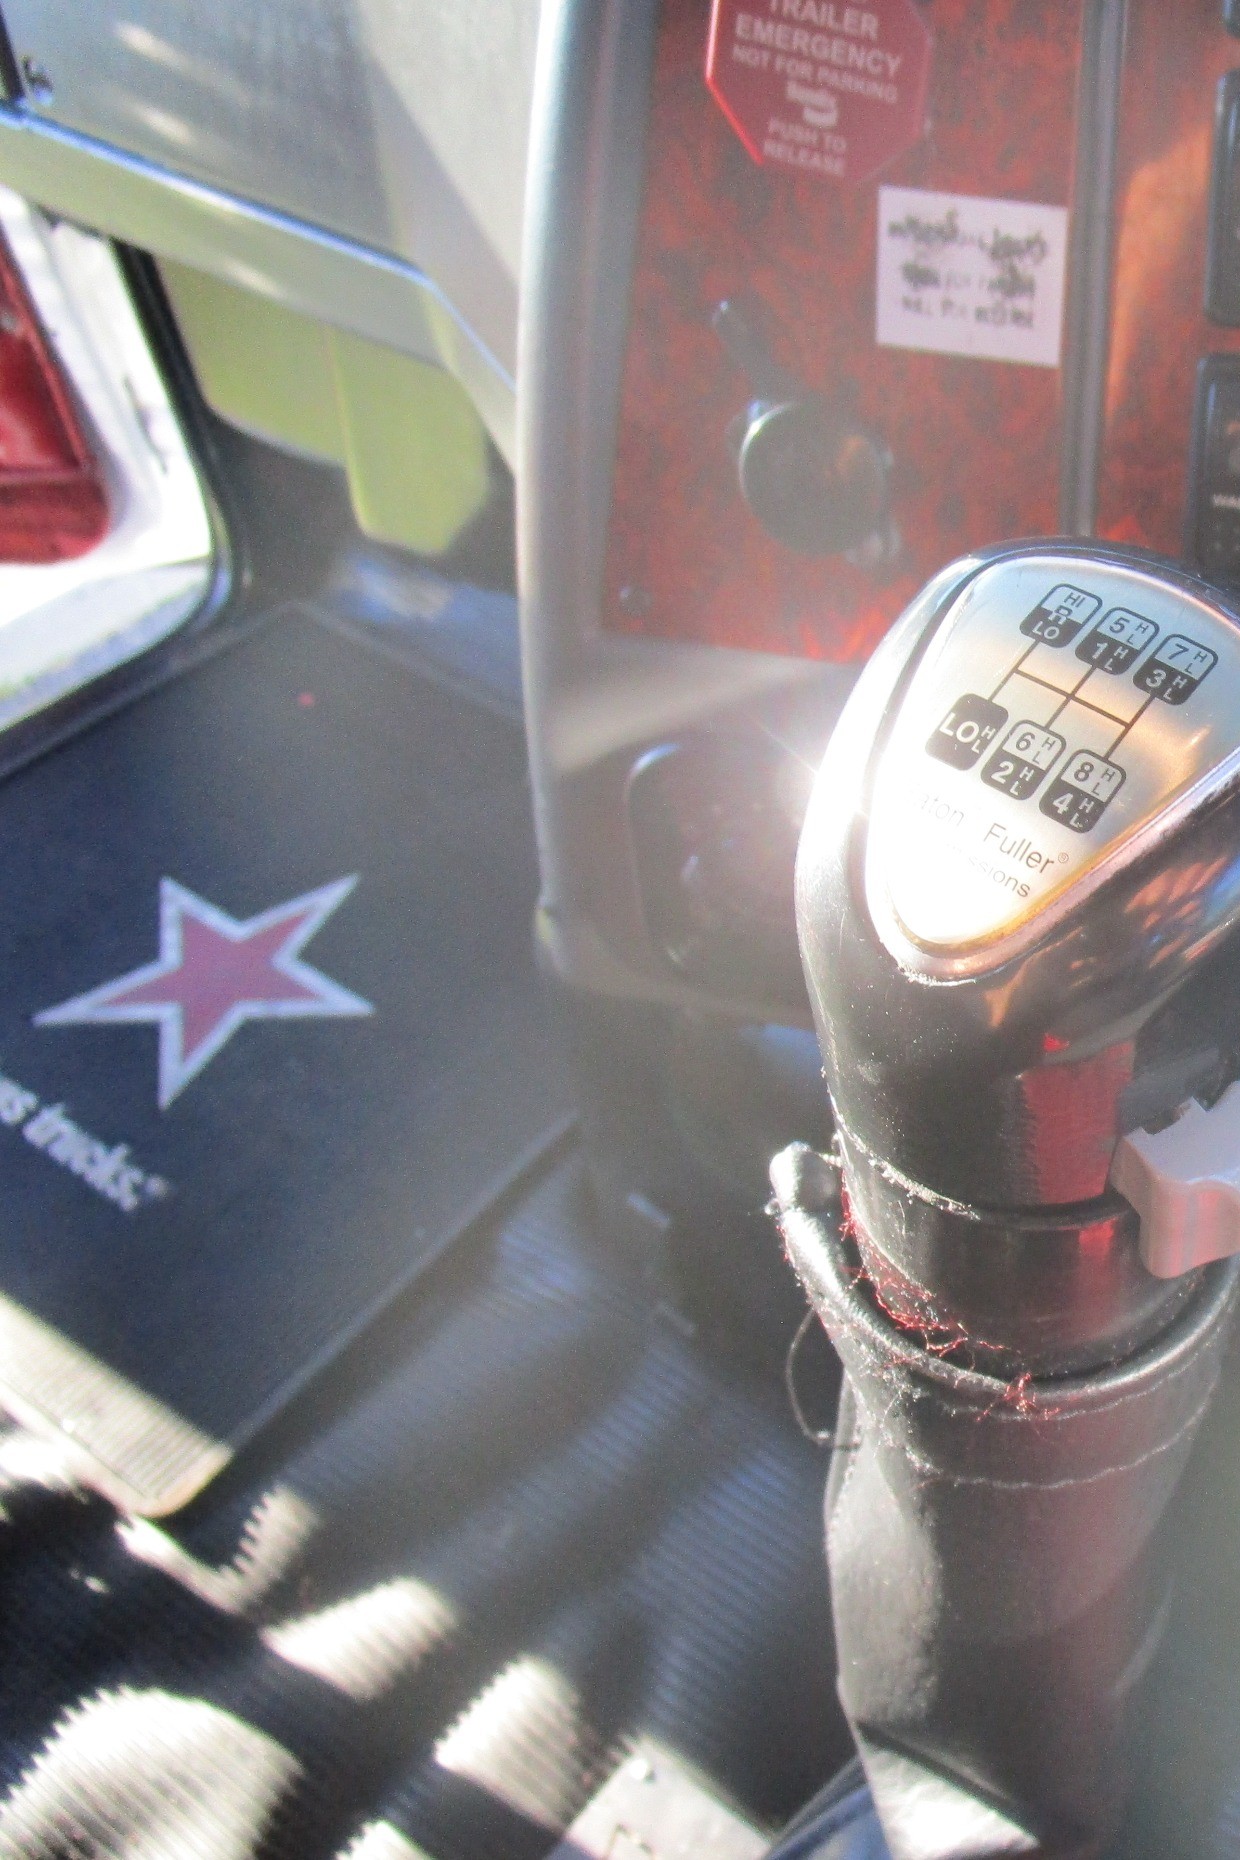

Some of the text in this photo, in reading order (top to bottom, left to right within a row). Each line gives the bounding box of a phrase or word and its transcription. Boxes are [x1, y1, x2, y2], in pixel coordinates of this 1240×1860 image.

[735, 13, 900, 77] EMERGENCY
[732, 44, 898, 103] NOT FOR PARKING
[824, 134, 847, 154] TO
[764, 139, 844, 175] RELEASE
[1064, 593, 1086, 608] HI
[1048, 605, 1073, 625] R
[1032, 621, 1060, 640] LO
[1109, 617, 1150, 634] 5 H
[1126, 634, 1134, 645] L
[1091, 643, 1129, 660] 1 H
[1167, 643, 1208, 663] 7 H
[1104, 659, 1114, 671] L
[1184, 662, 1193, 674] L
[1145, 669, 1188, 689] 3 H
[1163, 688, 1173, 700] L
[939, 712, 996, 743] LO H
[971, 739, 981, 754] L
[1015, 732, 1056, 752] 6 H
[1032, 750, 1041, 764] L
[991, 761, 1035, 784] 2 H
[1073, 761, 1116, 782] 8 H
[1010, 781, 1020, 795] L
[1091, 782, 1101, 796] L
[1053, 792, 1094, 814] 4 H
[1069, 813, 1082, 828] L
